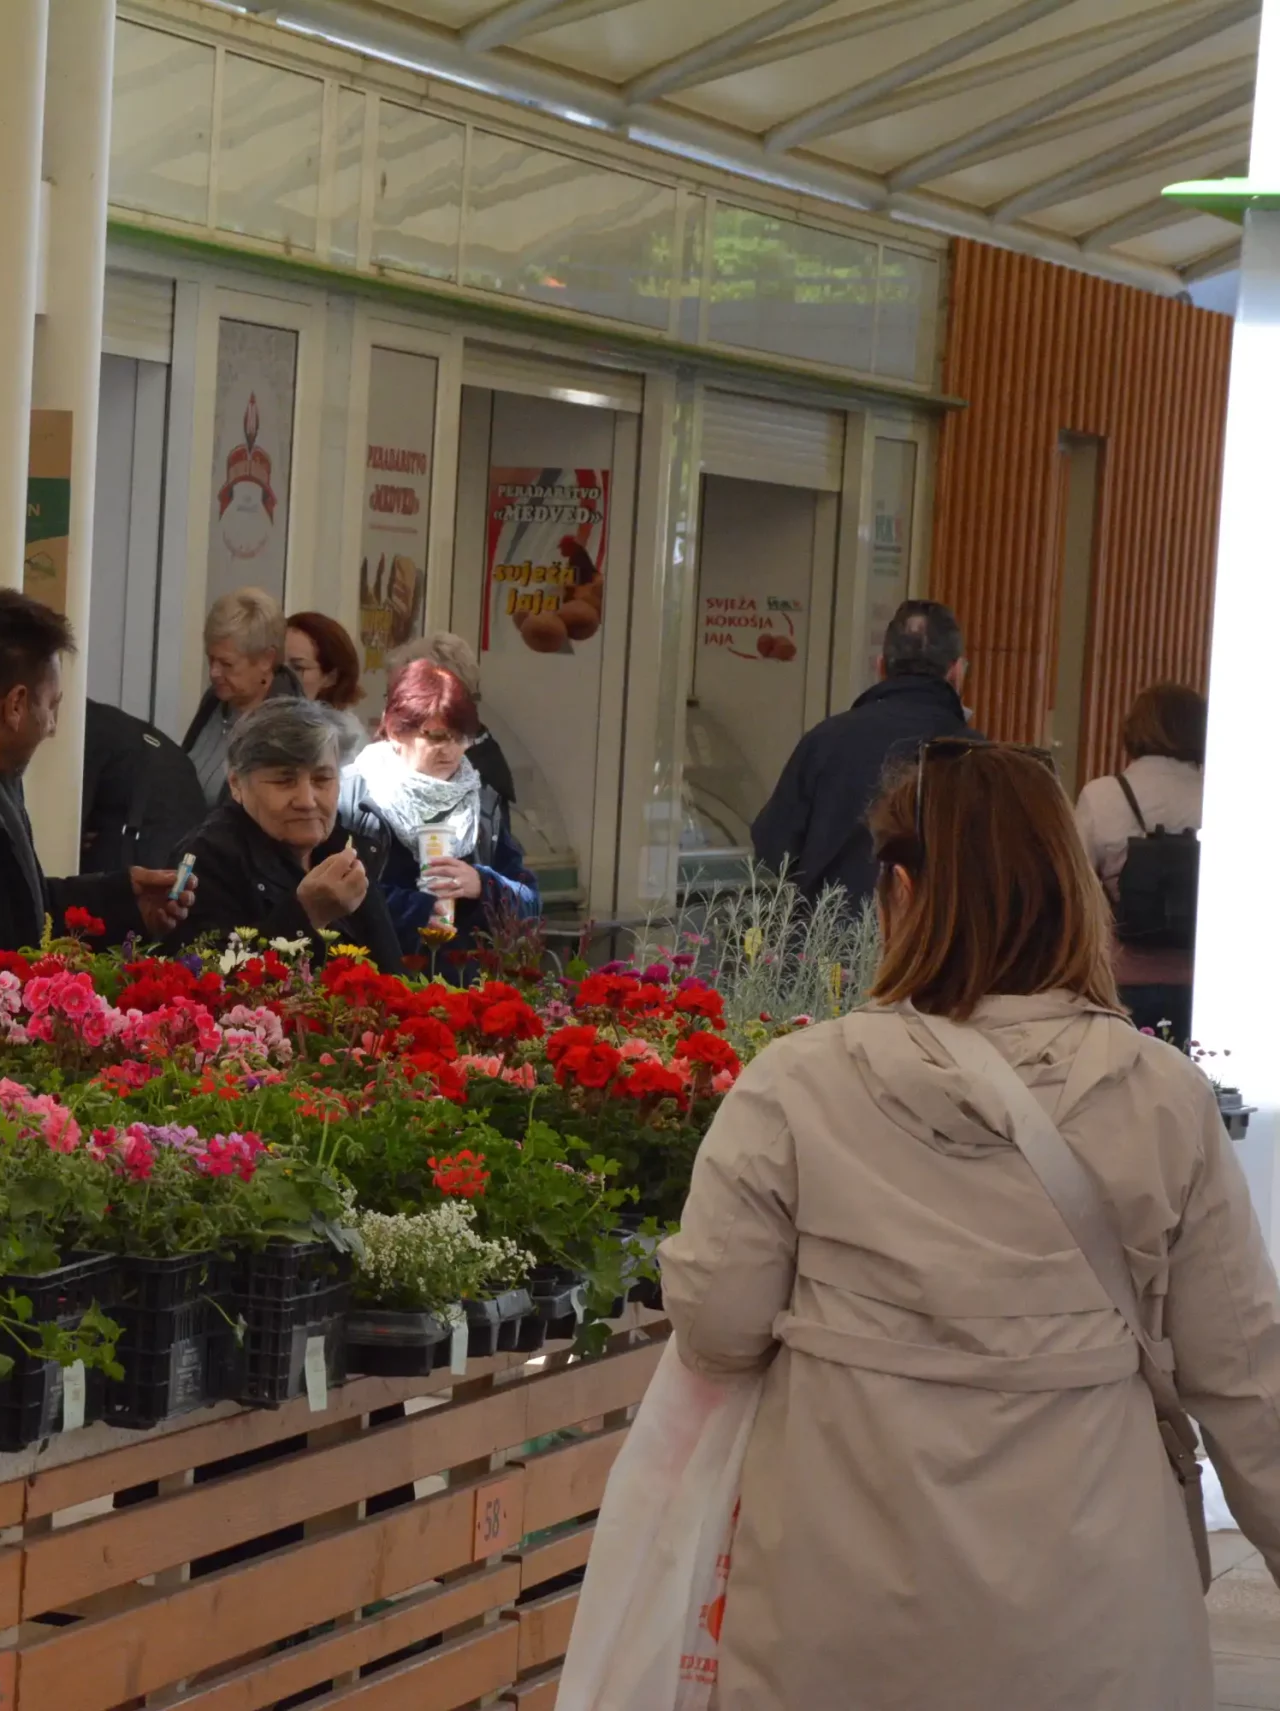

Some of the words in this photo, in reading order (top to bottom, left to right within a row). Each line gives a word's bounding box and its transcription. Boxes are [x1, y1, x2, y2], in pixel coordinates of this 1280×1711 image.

[498, 485, 602, 501] PERADARSTVO
[706, 595, 757, 613] SVJEŽA
[705, 614, 773, 630] KOKOŠJA
[704, 632, 734, 646] JAJA
[484, 1498, 500, 1542] 58
